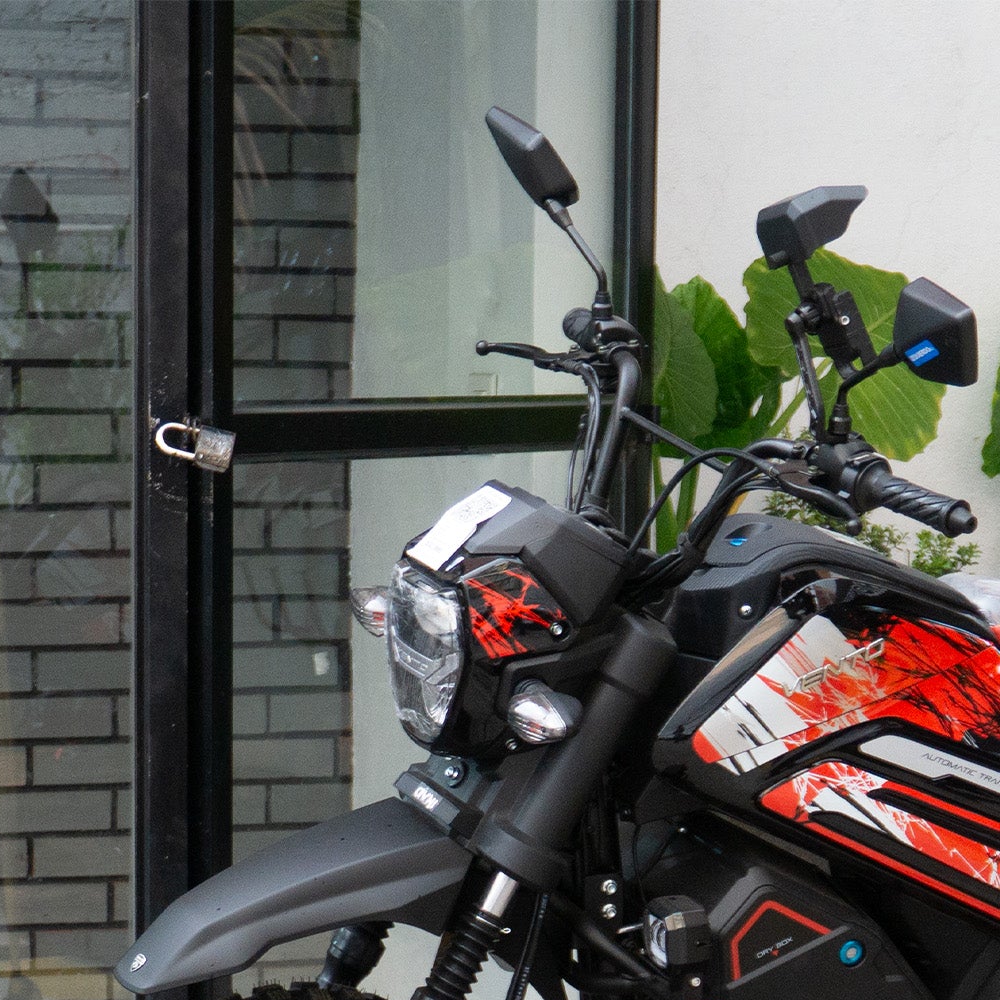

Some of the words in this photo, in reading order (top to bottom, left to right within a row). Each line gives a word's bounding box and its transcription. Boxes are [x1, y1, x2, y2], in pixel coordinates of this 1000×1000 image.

[782, 637, 885, 698] VENTO
[920, 752, 978, 777] AUTOMATIC
[756, 945, 774, 959] DRY
